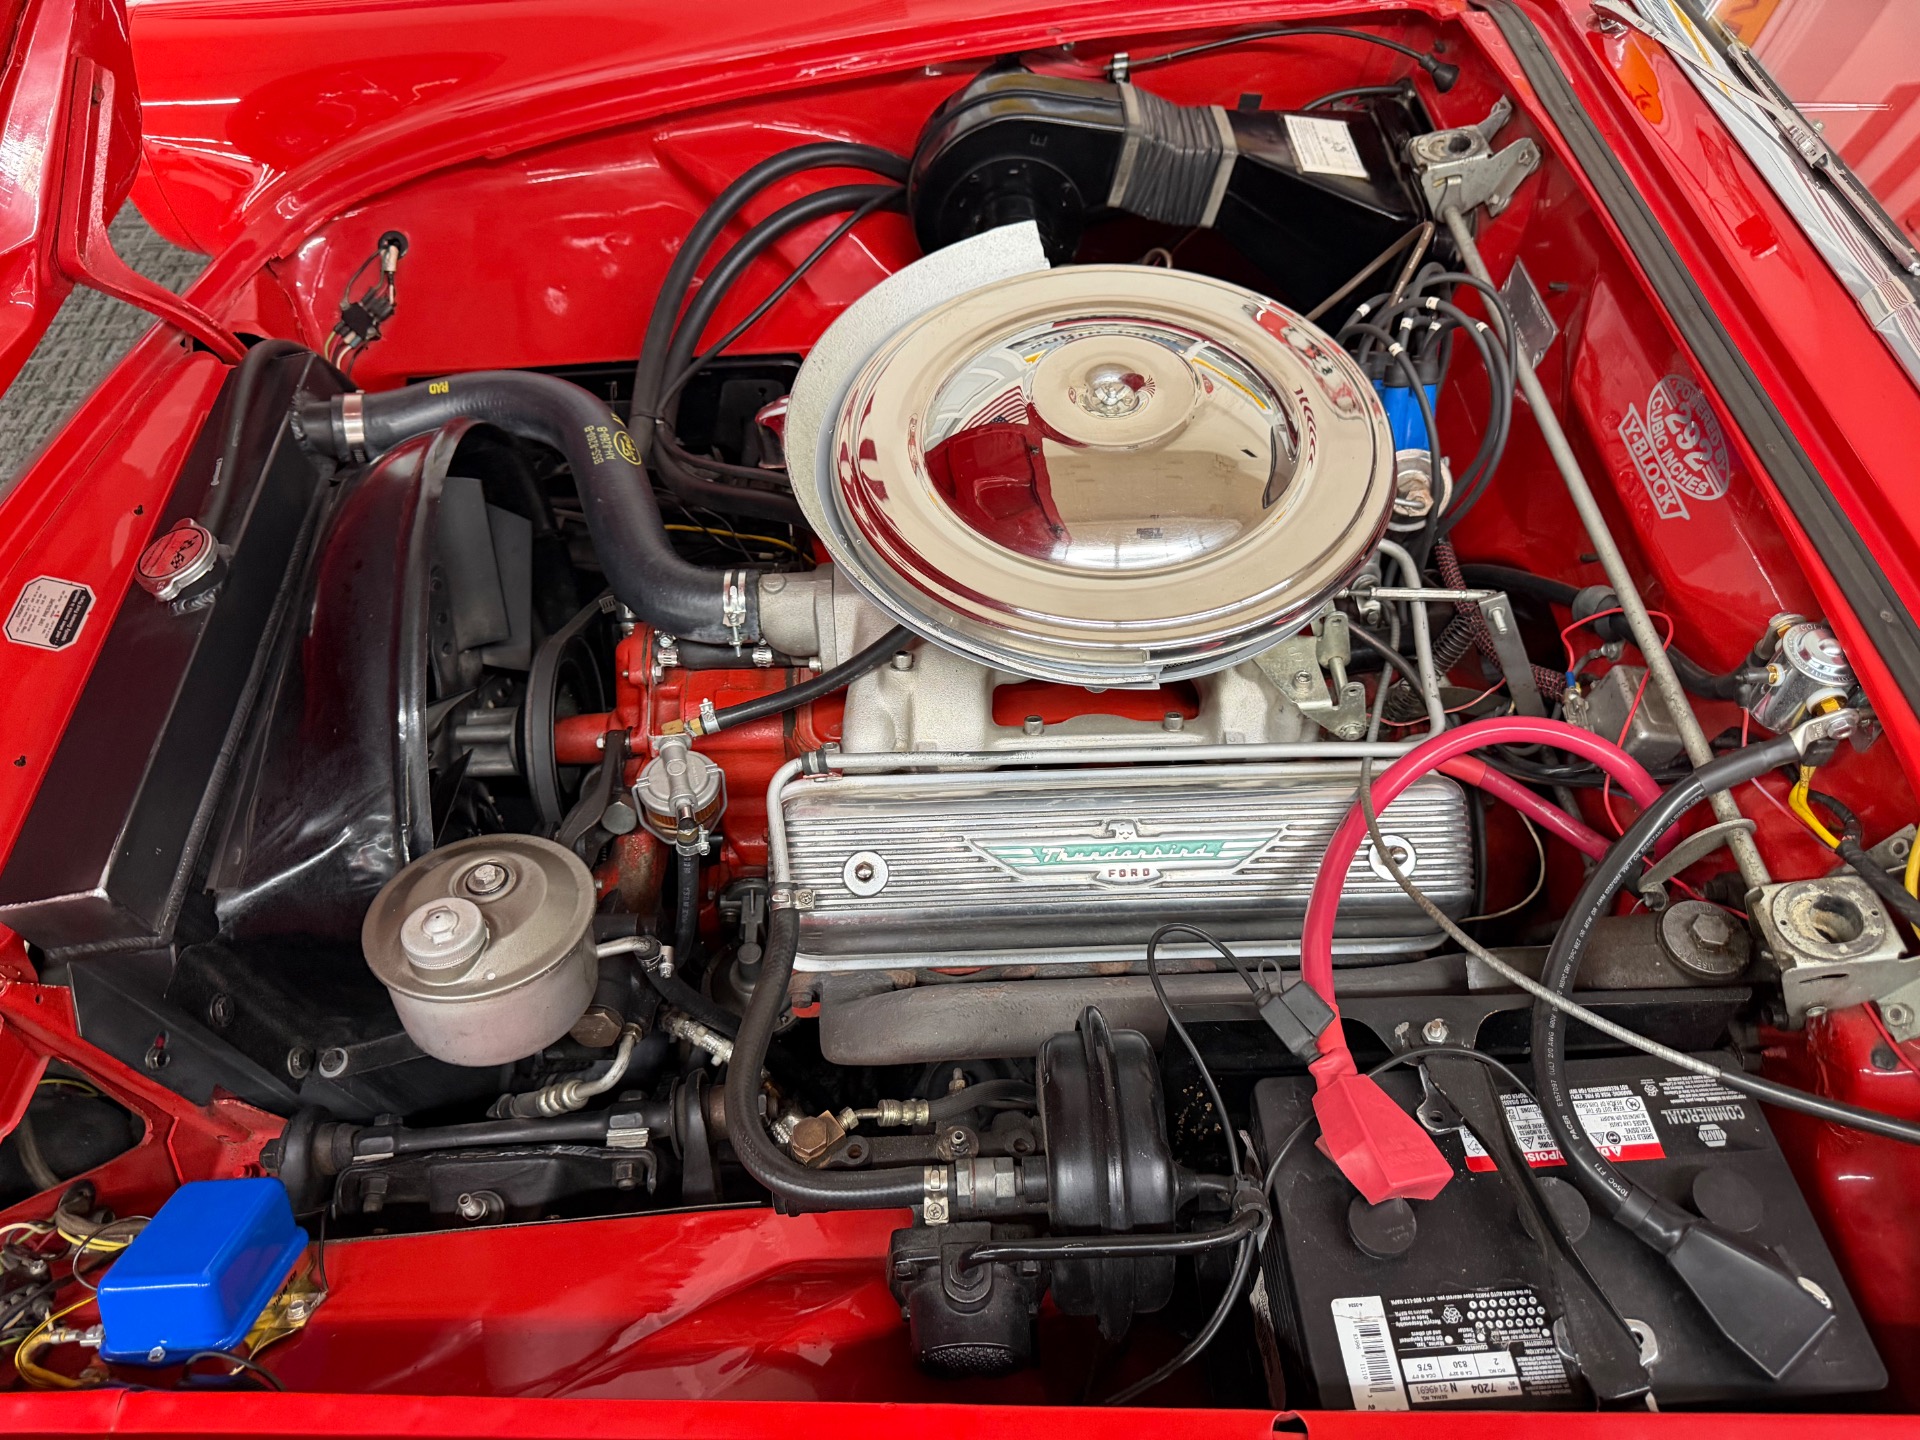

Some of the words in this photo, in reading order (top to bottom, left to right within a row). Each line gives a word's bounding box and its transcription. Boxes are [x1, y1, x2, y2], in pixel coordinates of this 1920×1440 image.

[428, 381, 449, 394] RAD
[1674, 380, 1720, 446] POWERED
[1714, 448, 1727, 472] BY
[1665, 402, 1712, 471] 292
[1651, 396, 1668, 449] CUBIC
[1661, 448, 1709, 494] INCHES
[1624, 418, 1676, 513] Y-BLOCK
[1641, 828, 1664, 854] RESISTANT
[1108, 868, 1150, 878] FORD
[1547, 1032, 1555, 1047] AWG
[1661, 1105, 1745, 1125] COMMERCIAL
[1562, 1115, 1580, 1140] PACER
[1703, 1129, 1723, 1141] NAPA
[1417, 1363, 1433, 1371] 675
[1452, 1360, 1468, 1368] 830
[1450, 1383, 1458, 1393] N
[1471, 1383, 1497, 1394] 7204
